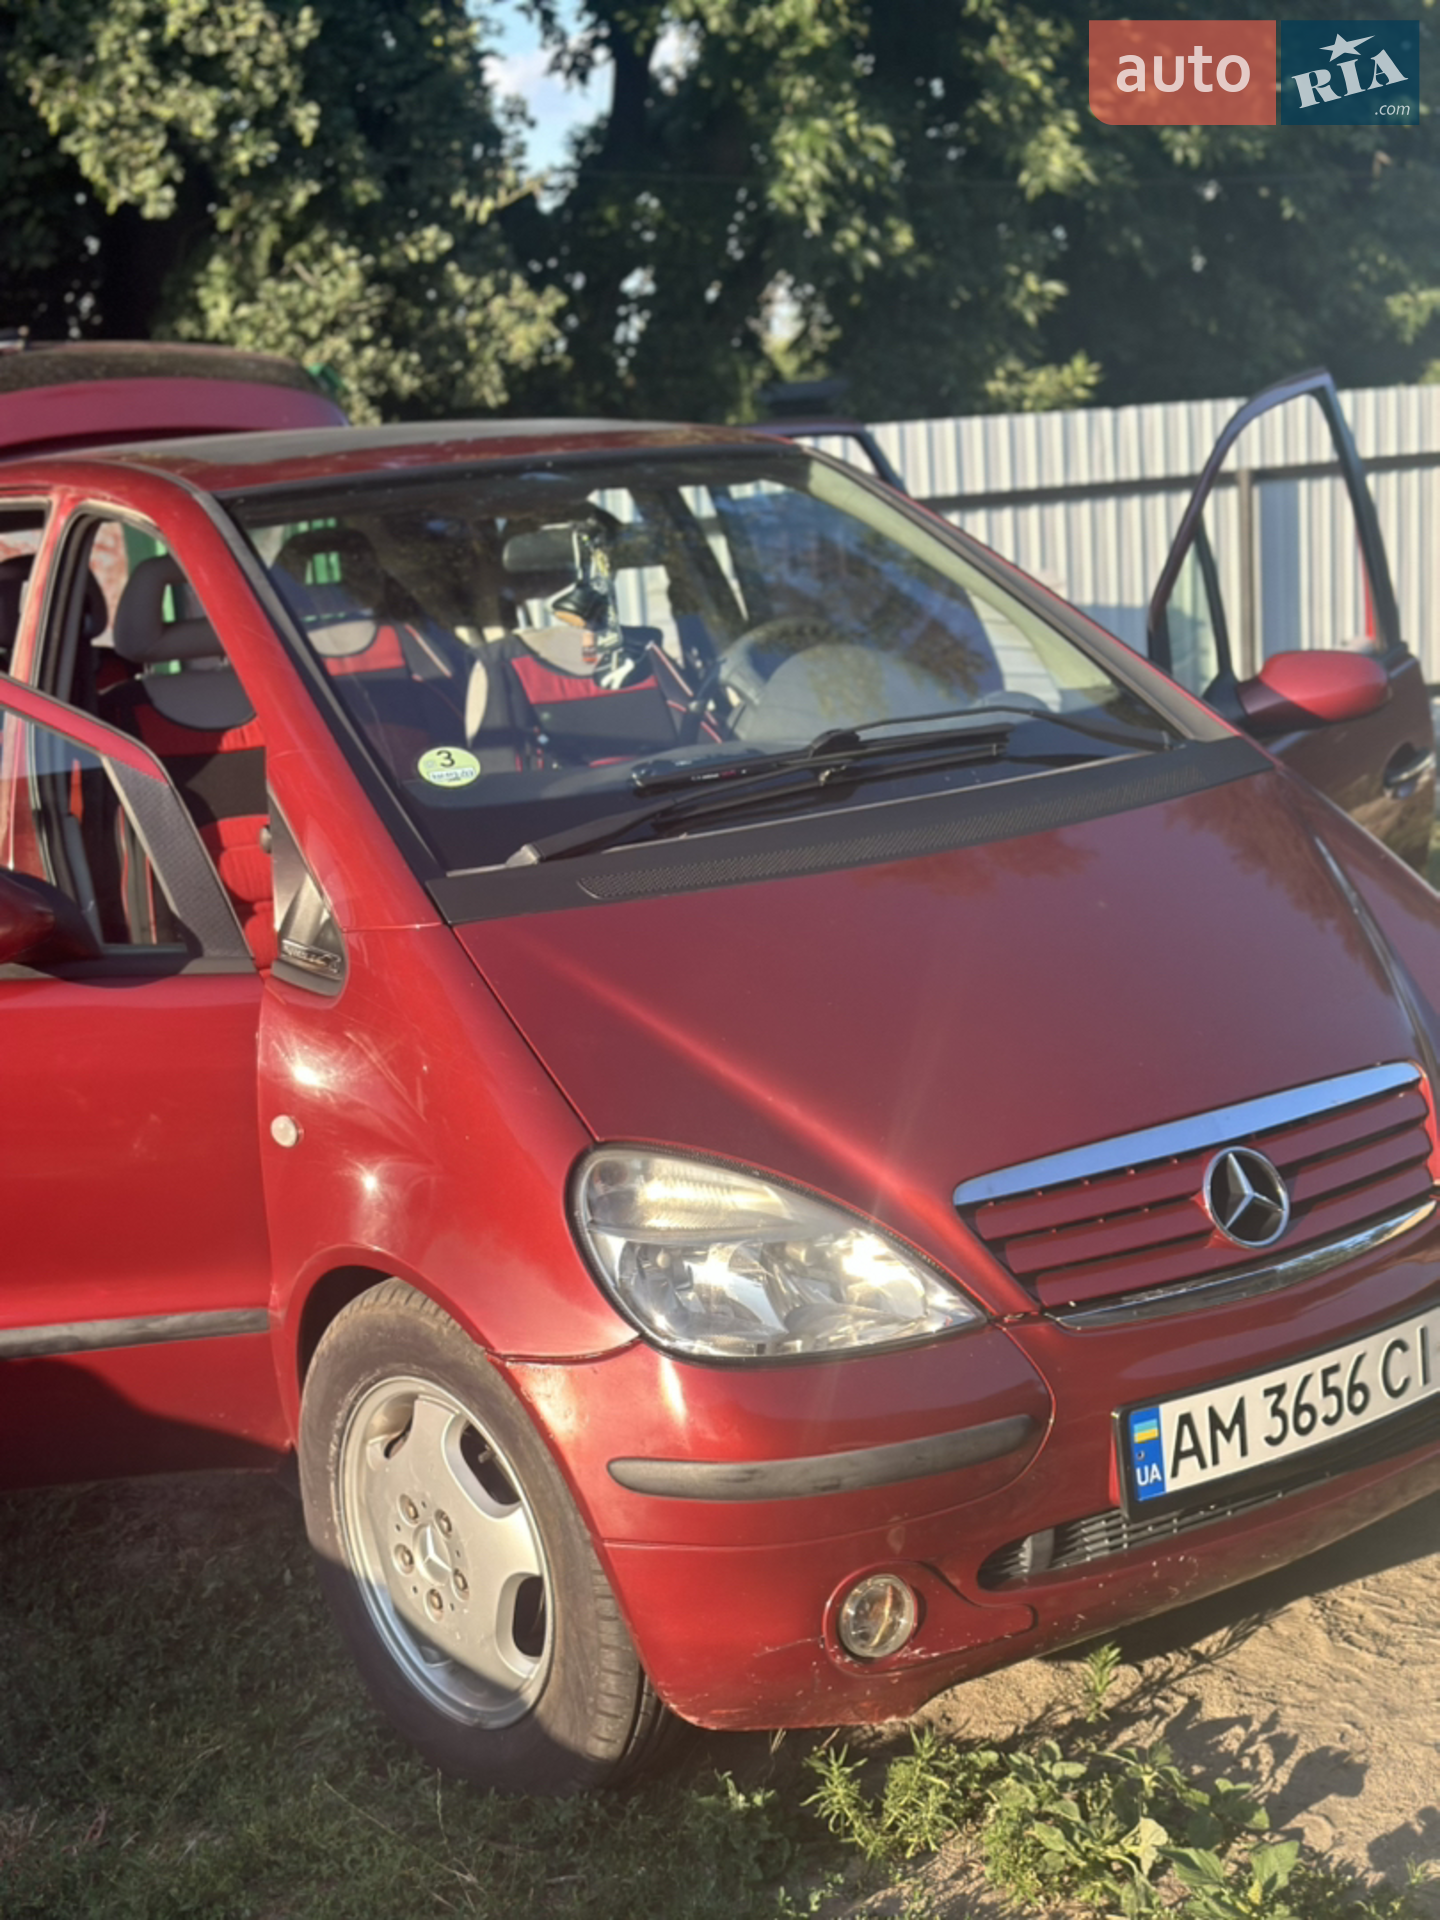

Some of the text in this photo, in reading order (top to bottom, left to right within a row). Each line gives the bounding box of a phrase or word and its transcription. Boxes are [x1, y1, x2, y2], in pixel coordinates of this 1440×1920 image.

[436, 749, 455, 768] 3
[1170, 1326, 1431, 1479] AM 3656 CI
[1136, 1463, 1161, 1486] UA
